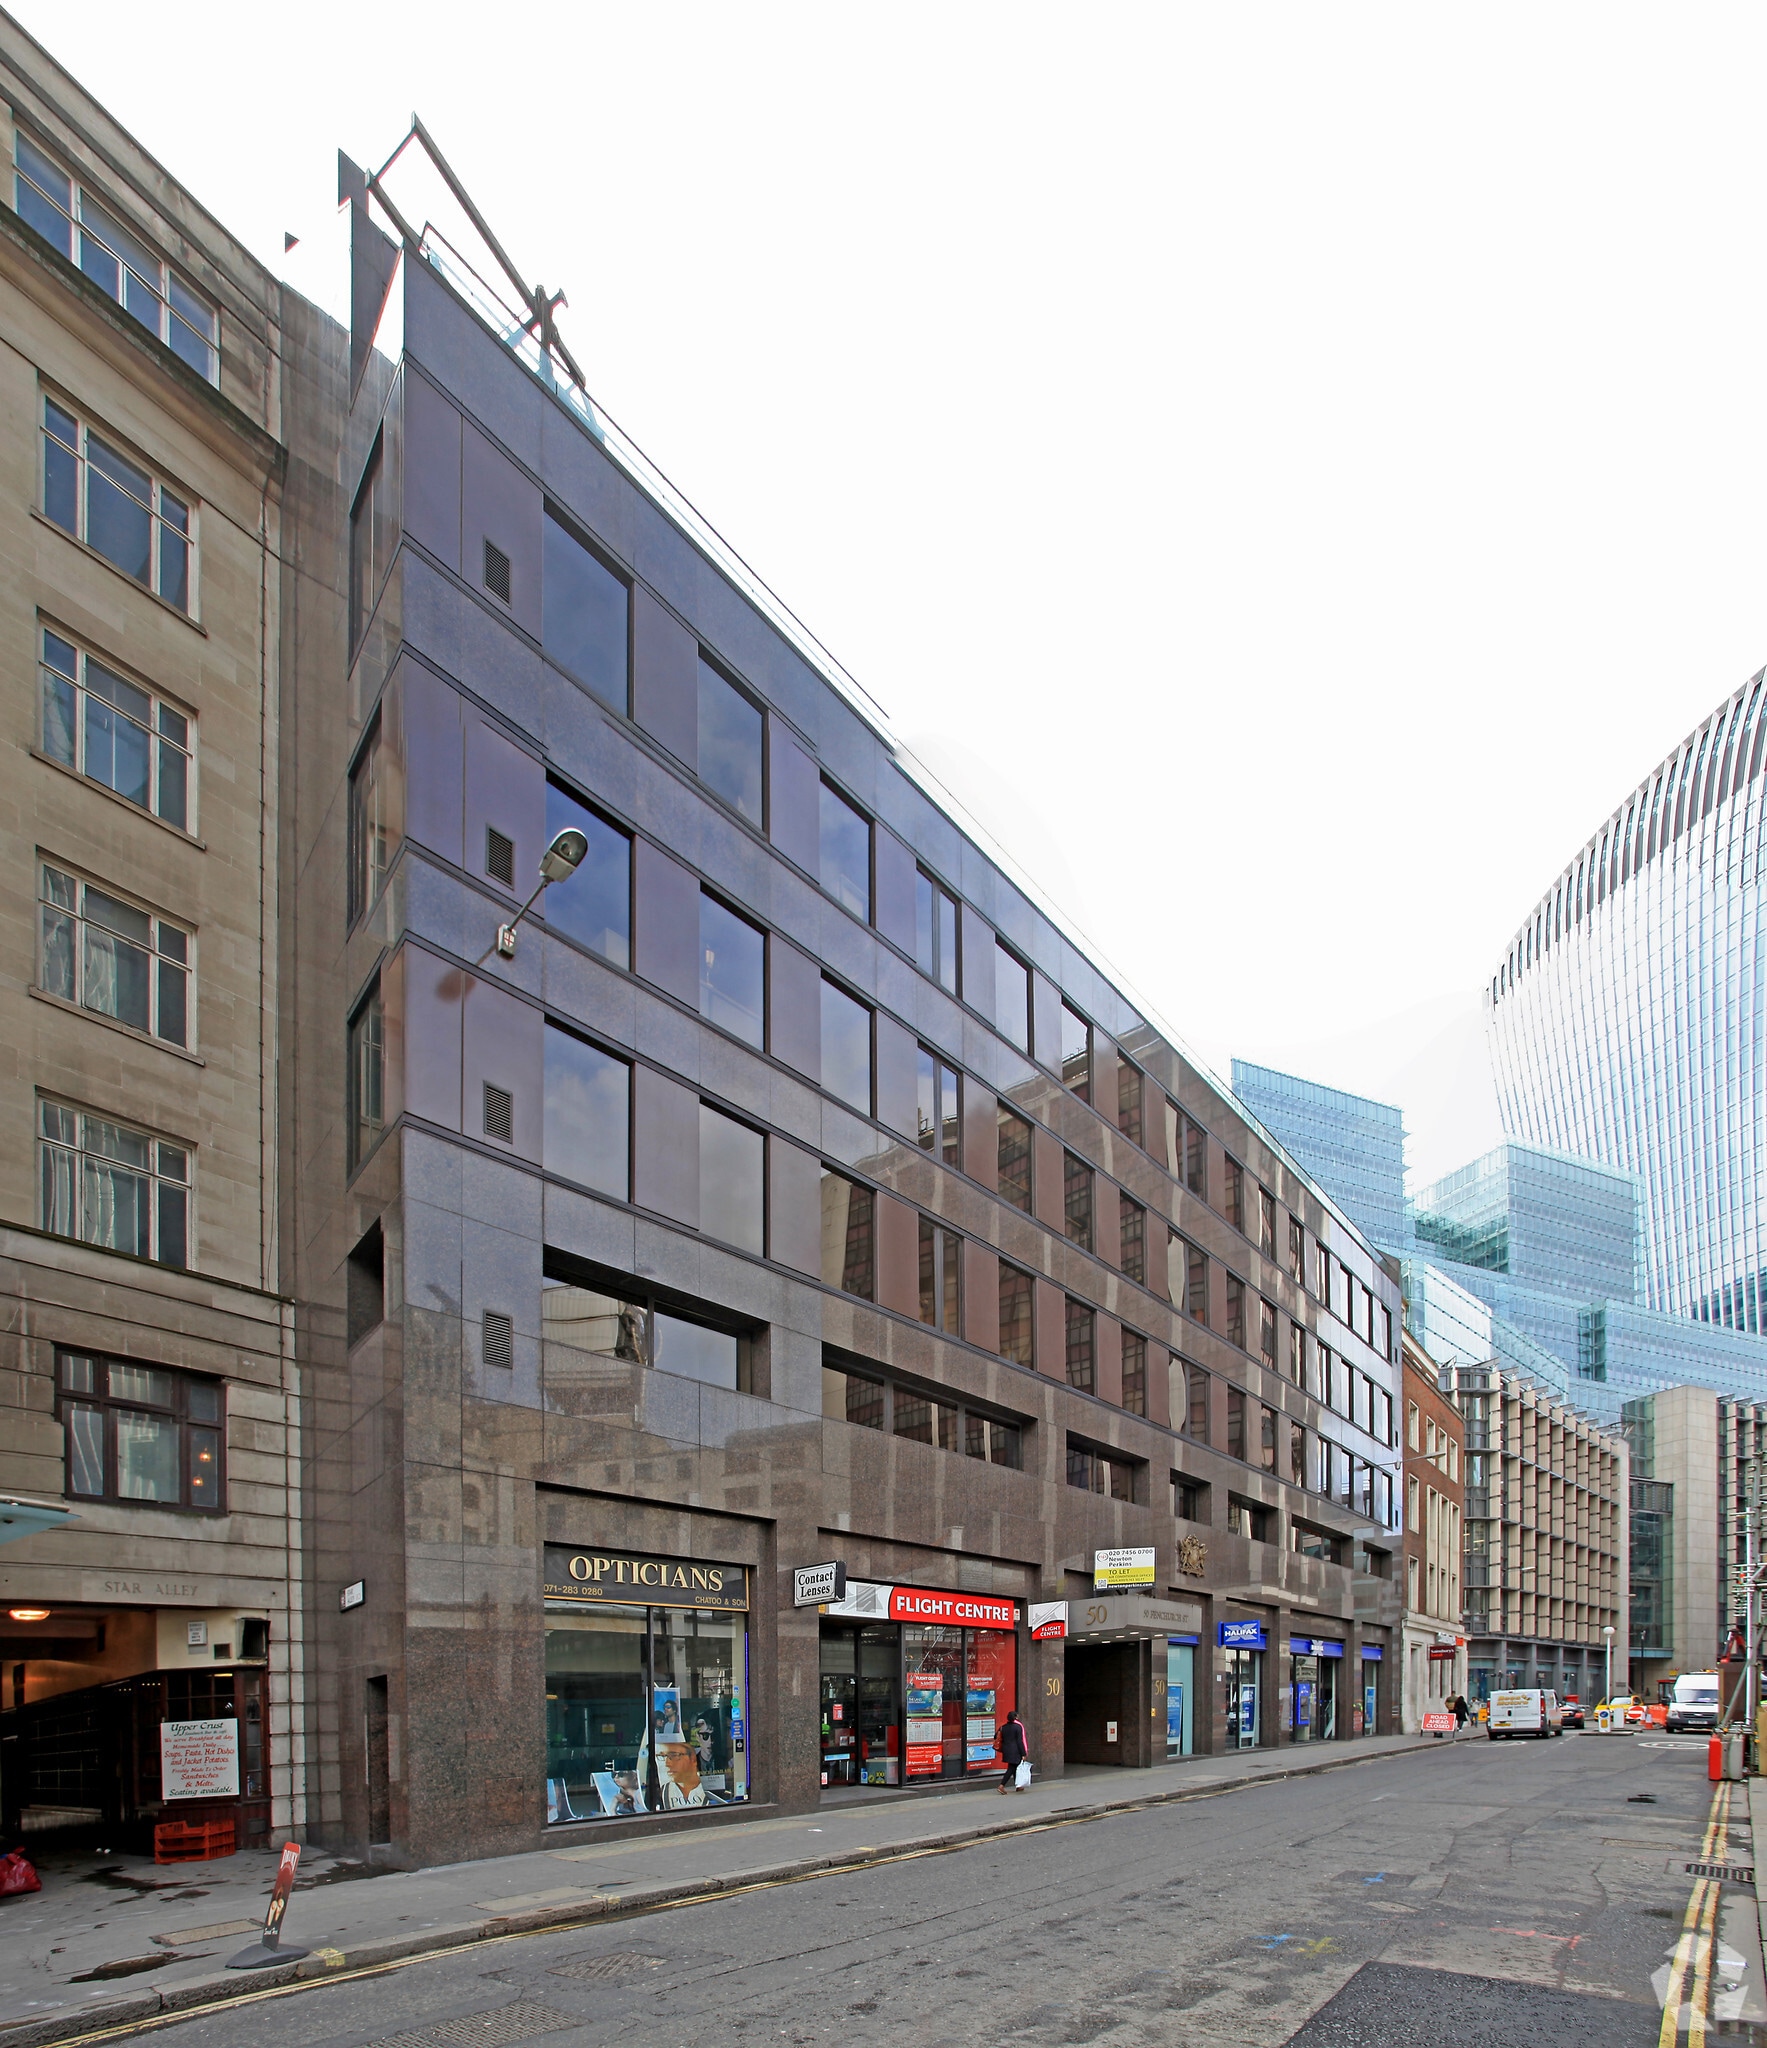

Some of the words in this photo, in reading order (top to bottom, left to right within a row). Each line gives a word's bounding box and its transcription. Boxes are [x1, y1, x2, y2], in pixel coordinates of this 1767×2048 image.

[568, 1556, 723, 1592] OPTICIANS
[798, 1570, 834, 1586] Contact
[105, 1581, 142, 1594] STAR
[156, 1584, 198, 1596] ALLEY
[544, 1584, 578, 1594] 071-283
[582, 1586, 603, 1596] 0280
[800, 1584, 831, 1597] Lenses
[695, 1596, 722, 1605] CHATOO
[896, 1596, 954, 1616] FLIGHT
[955, 1602, 1009, 1621] CENTRE
[1086, 1605, 1107, 1626] 50
[1225, 1628, 1258, 1637] HALIFAX
[1046, 1678, 1060, 1696] 50
[1155, 1680, 1165, 1695] 50
[171, 1724, 198, 1736] Upper
[182, 1757, 202, 1766] Jacket
[200, 1786, 232, 1794] available
[671, 1795, 702, 1807] POLO
